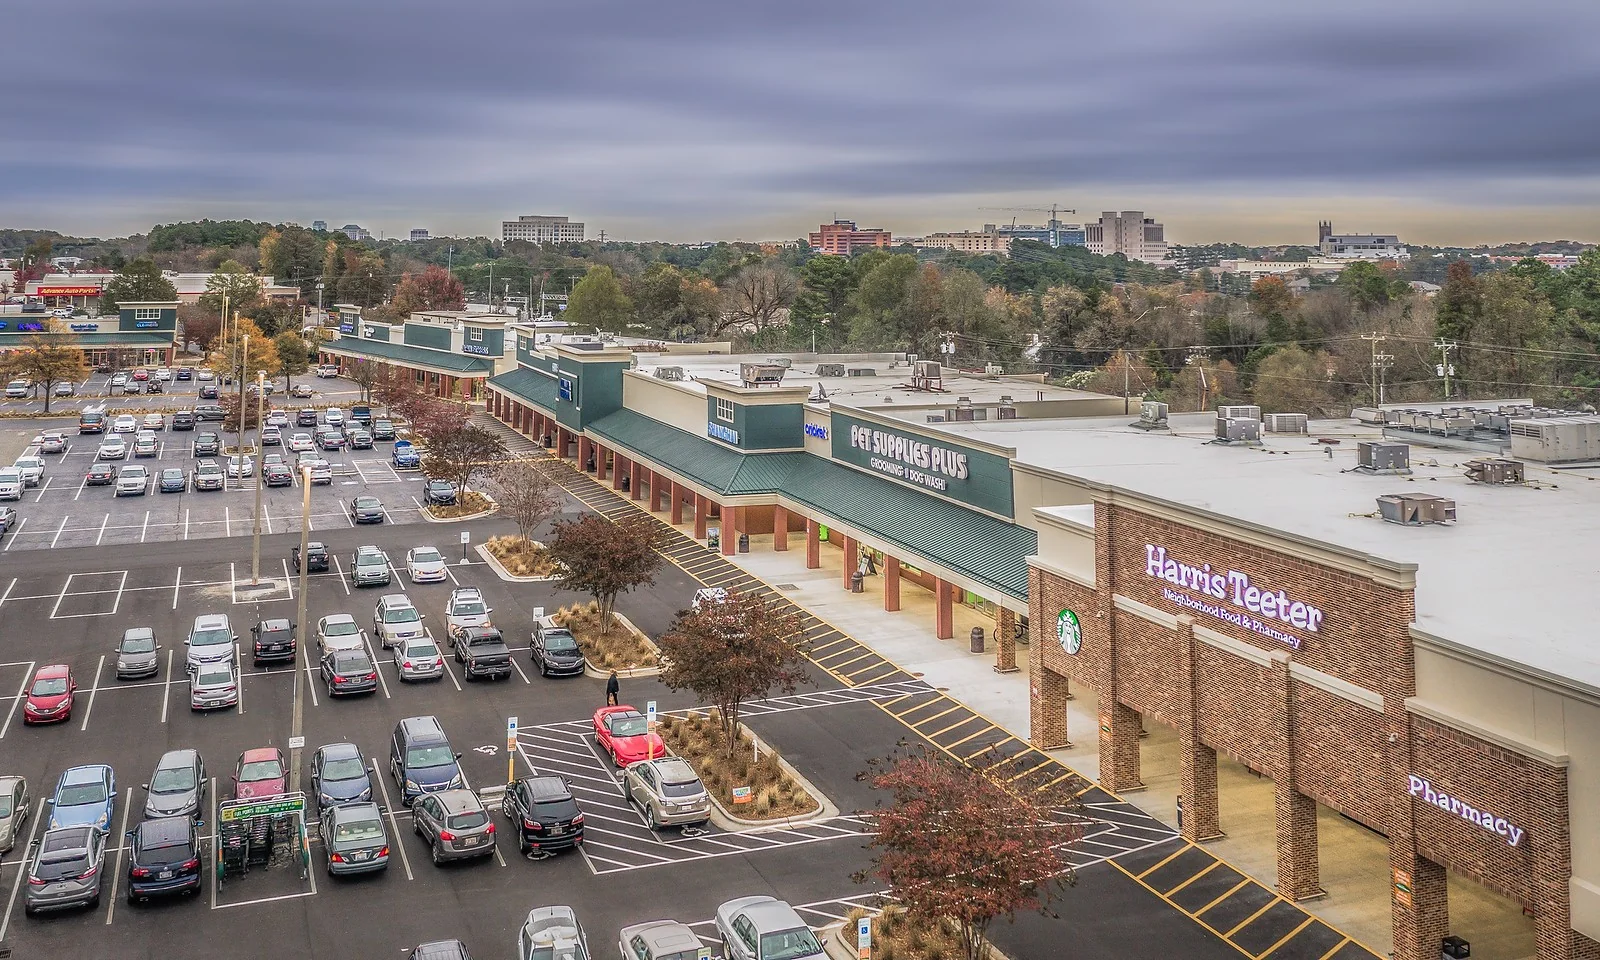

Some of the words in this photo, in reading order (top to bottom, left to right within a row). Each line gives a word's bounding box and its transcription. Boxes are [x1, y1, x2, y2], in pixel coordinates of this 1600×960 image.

[804, 422, 828, 439] cricket
[851, 424, 872, 451] PET
[873, 430, 930, 468] SUPPLIES
[931, 446, 968, 479] PLUS
[870, 457, 903, 476] GROOMING
[909, 469, 924, 483] DOG
[924, 474, 946, 491] WASH
[1145, 544, 1227, 599] Harris
[1227, 569, 1323, 632] Teeter
[1163, 588, 1219, 618] Neighborhood
[1220, 608, 1241, 626] Food
[1242, 615, 1252, 628] &
[1252, 620, 1302, 649] Pharmacy
[1408, 774, 1526, 847] Pharmacy
